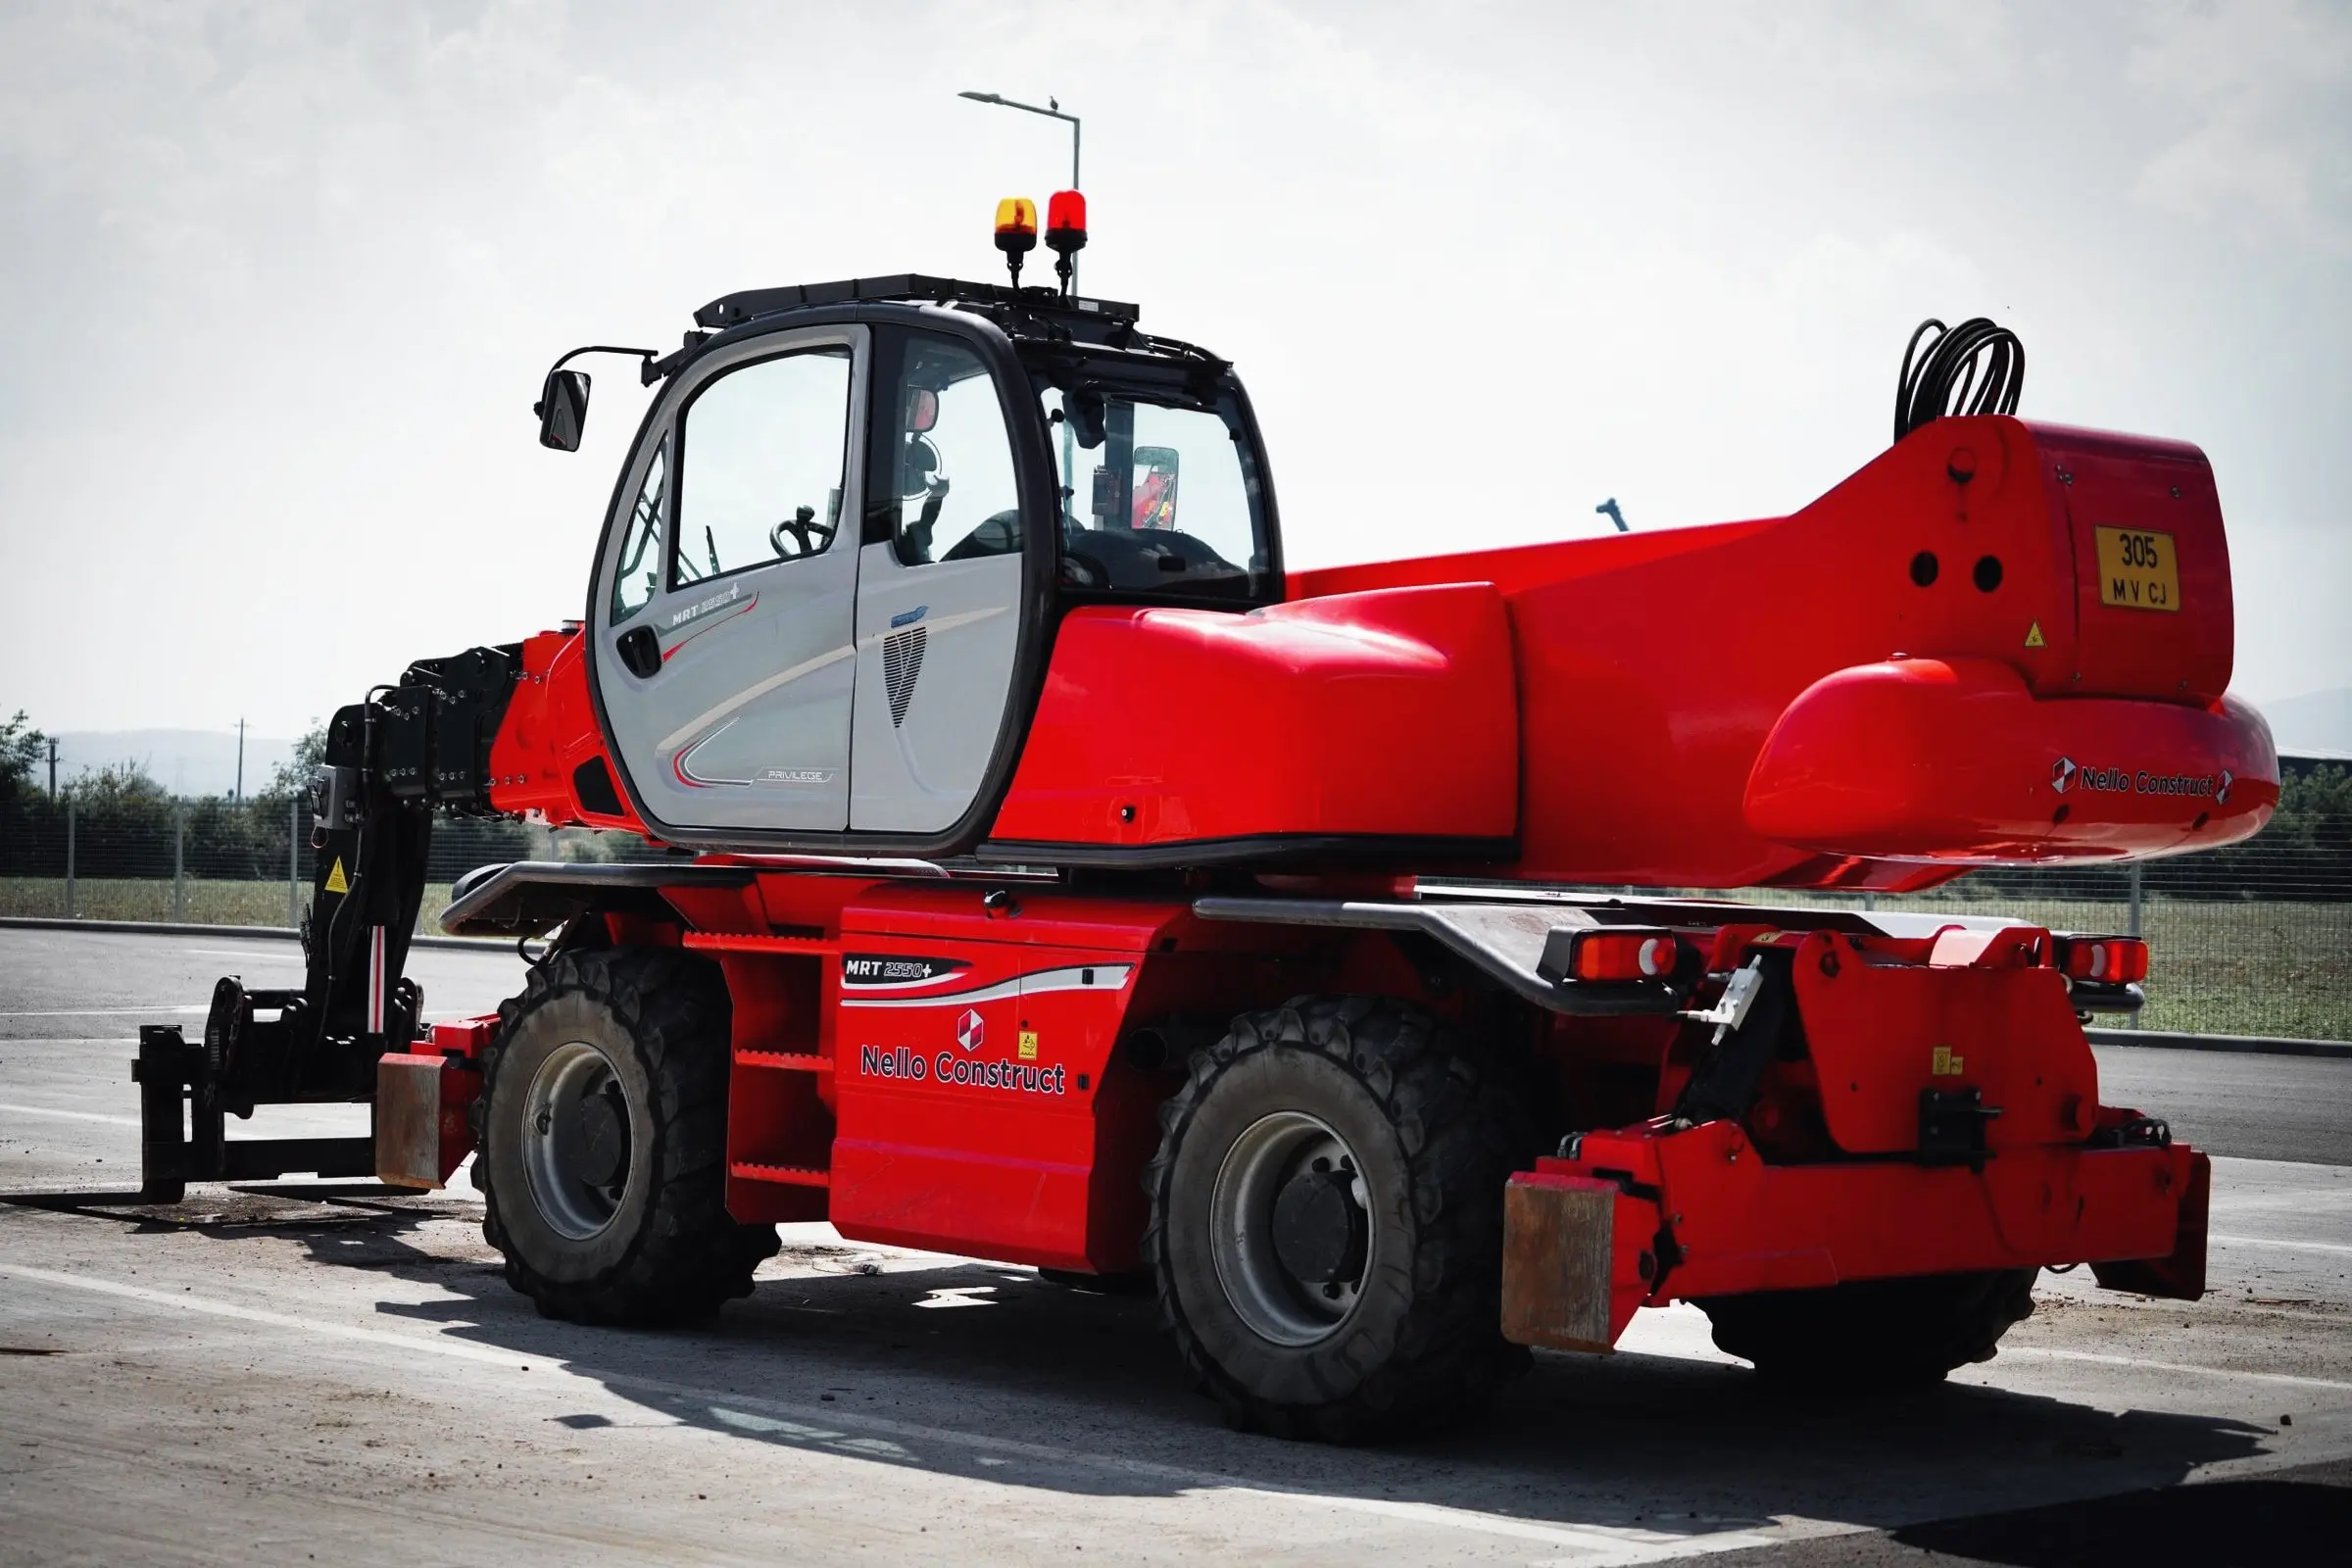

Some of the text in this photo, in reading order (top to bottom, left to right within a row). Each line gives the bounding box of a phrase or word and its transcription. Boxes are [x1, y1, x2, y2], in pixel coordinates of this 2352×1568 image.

[2119, 533, 2157, 568] 305
[672, 604, 699, 625] MRT
[768, 770, 822, 780] PRIVILEGE
[2081, 765, 2213, 797] Nello Construct
[846, 960, 932, 977] MRT 2550+
[861, 1045, 1065, 1095] Nello Construct
